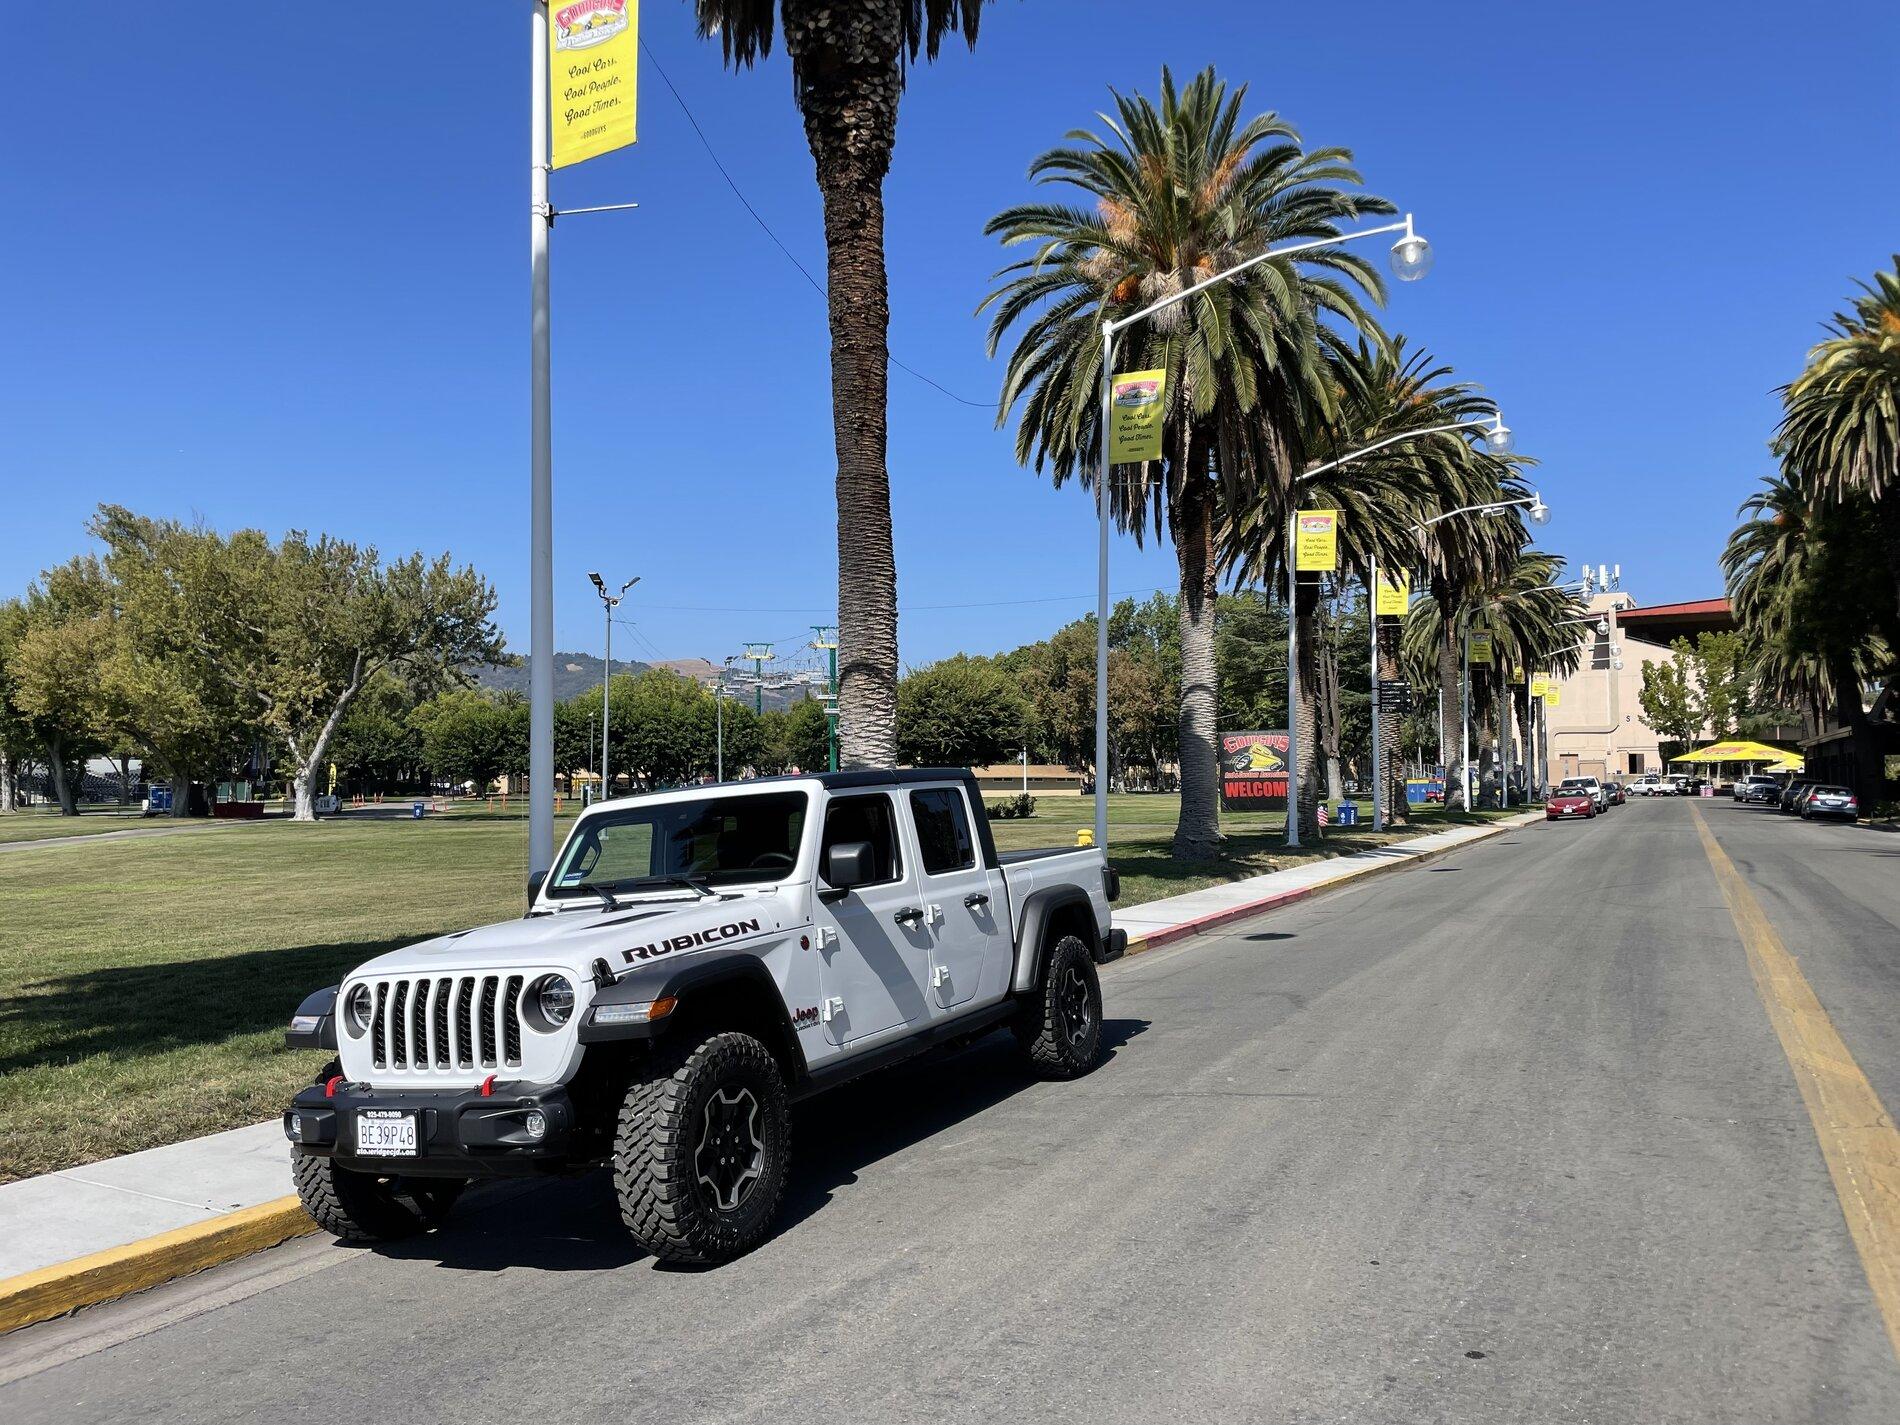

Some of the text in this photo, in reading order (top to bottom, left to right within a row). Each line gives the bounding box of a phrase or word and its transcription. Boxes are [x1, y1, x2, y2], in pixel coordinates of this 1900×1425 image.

[568, 58, 617, 78] Cool Cars.
[564, 76, 621, 101] Cool People.
[564, 97, 621, 126] Good Times.
[1225, 781, 1289, 798] WELCOM
[621, 918, 760, 964] RUBICON
[793, 1006, 819, 1023] Jeep
[361, 1126, 414, 1146] BE39P48
